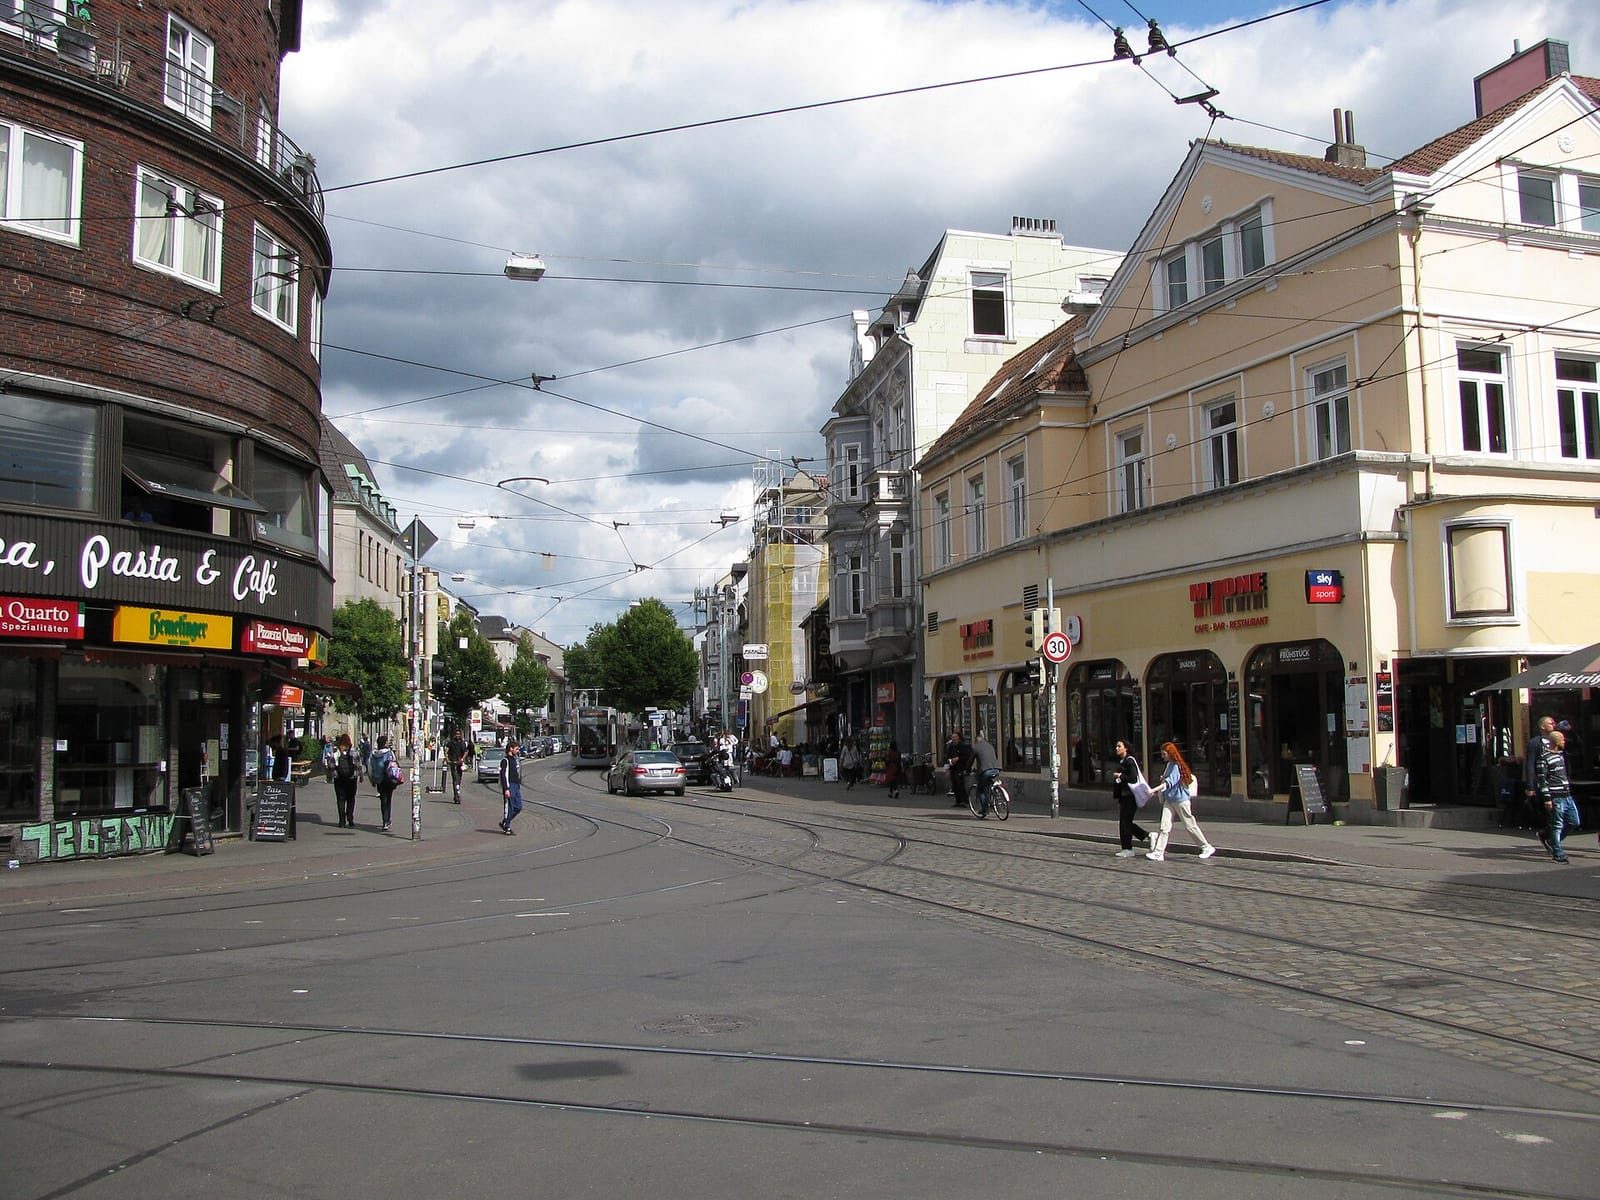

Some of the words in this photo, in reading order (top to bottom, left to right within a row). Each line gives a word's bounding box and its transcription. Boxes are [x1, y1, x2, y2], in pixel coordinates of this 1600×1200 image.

[81, 534, 181, 589] Pasta
[196, 549, 220, 585] &
[233, 555, 278, 604] Café
[1316, 573, 1332, 586] sky
[1316, 591, 1335, 599] sport
[8, 601, 70, 623] Quarto
[2, 622, 69, 633] Spezialitäten
[1229, 616, 1268, 630] RESTAURANT
[257, 623, 282, 641] Pizzeria
[282, 628, 304, 645] Quarto
[1049, 640, 1065, 654] 30
